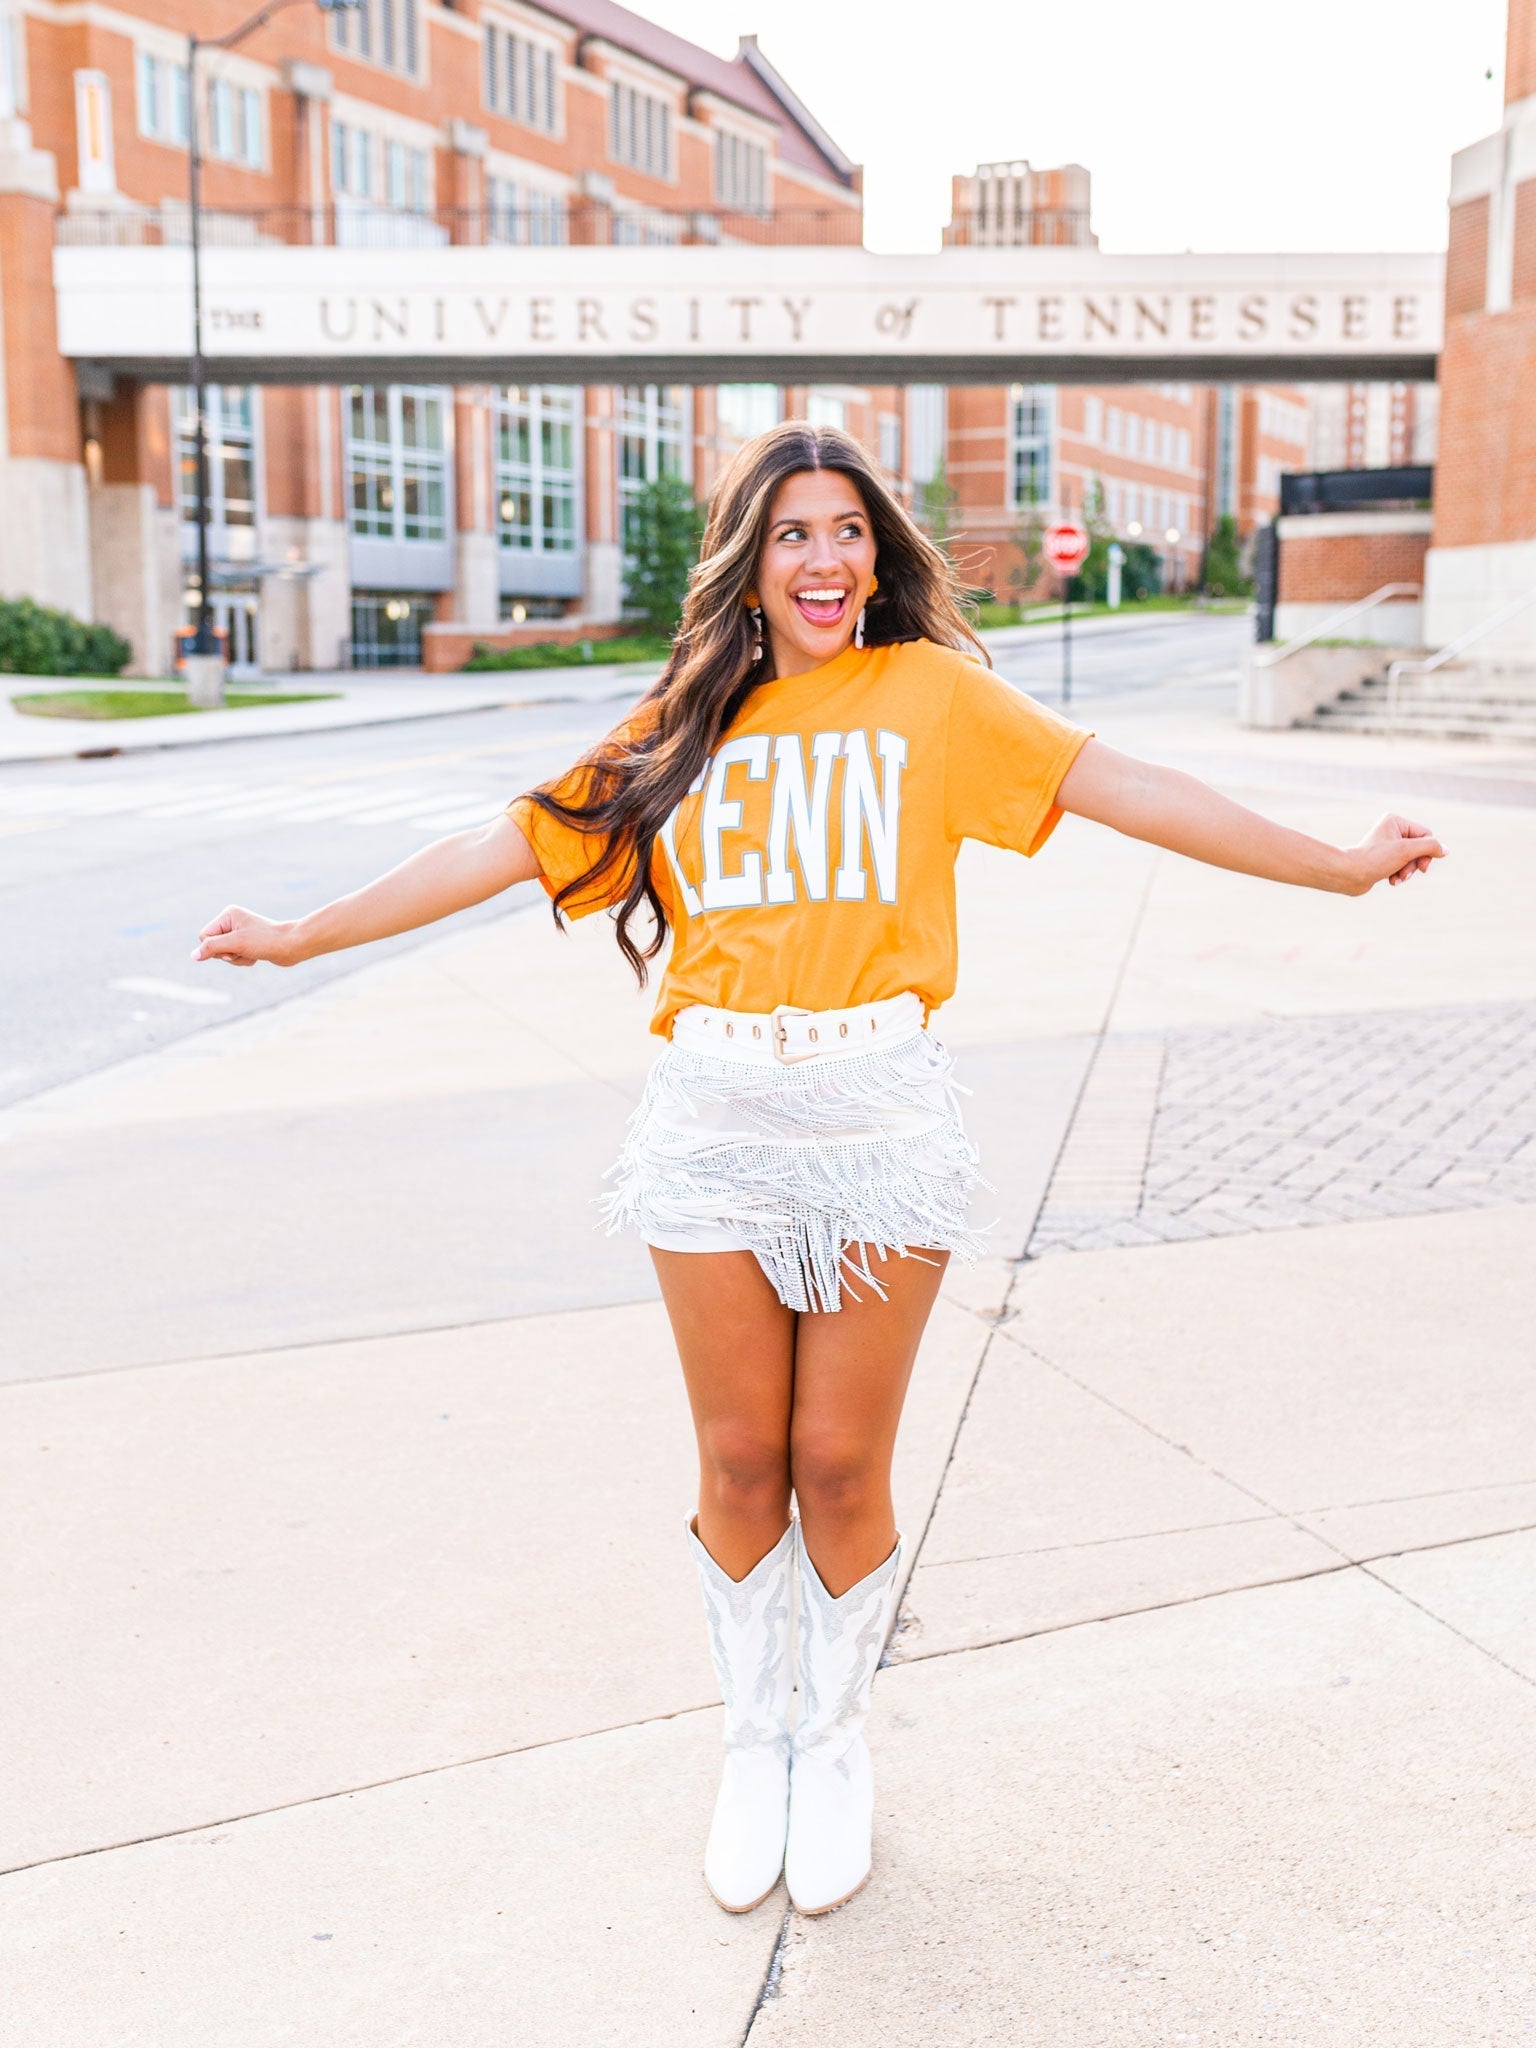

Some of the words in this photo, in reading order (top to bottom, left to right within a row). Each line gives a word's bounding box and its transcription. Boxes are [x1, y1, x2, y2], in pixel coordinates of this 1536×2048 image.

[210, 308, 264, 331] THE
[319, 297, 814, 342] UNIVERSITY
[874, 296, 922, 341] of
[982, 296, 1420, 341] TENNESSEE
